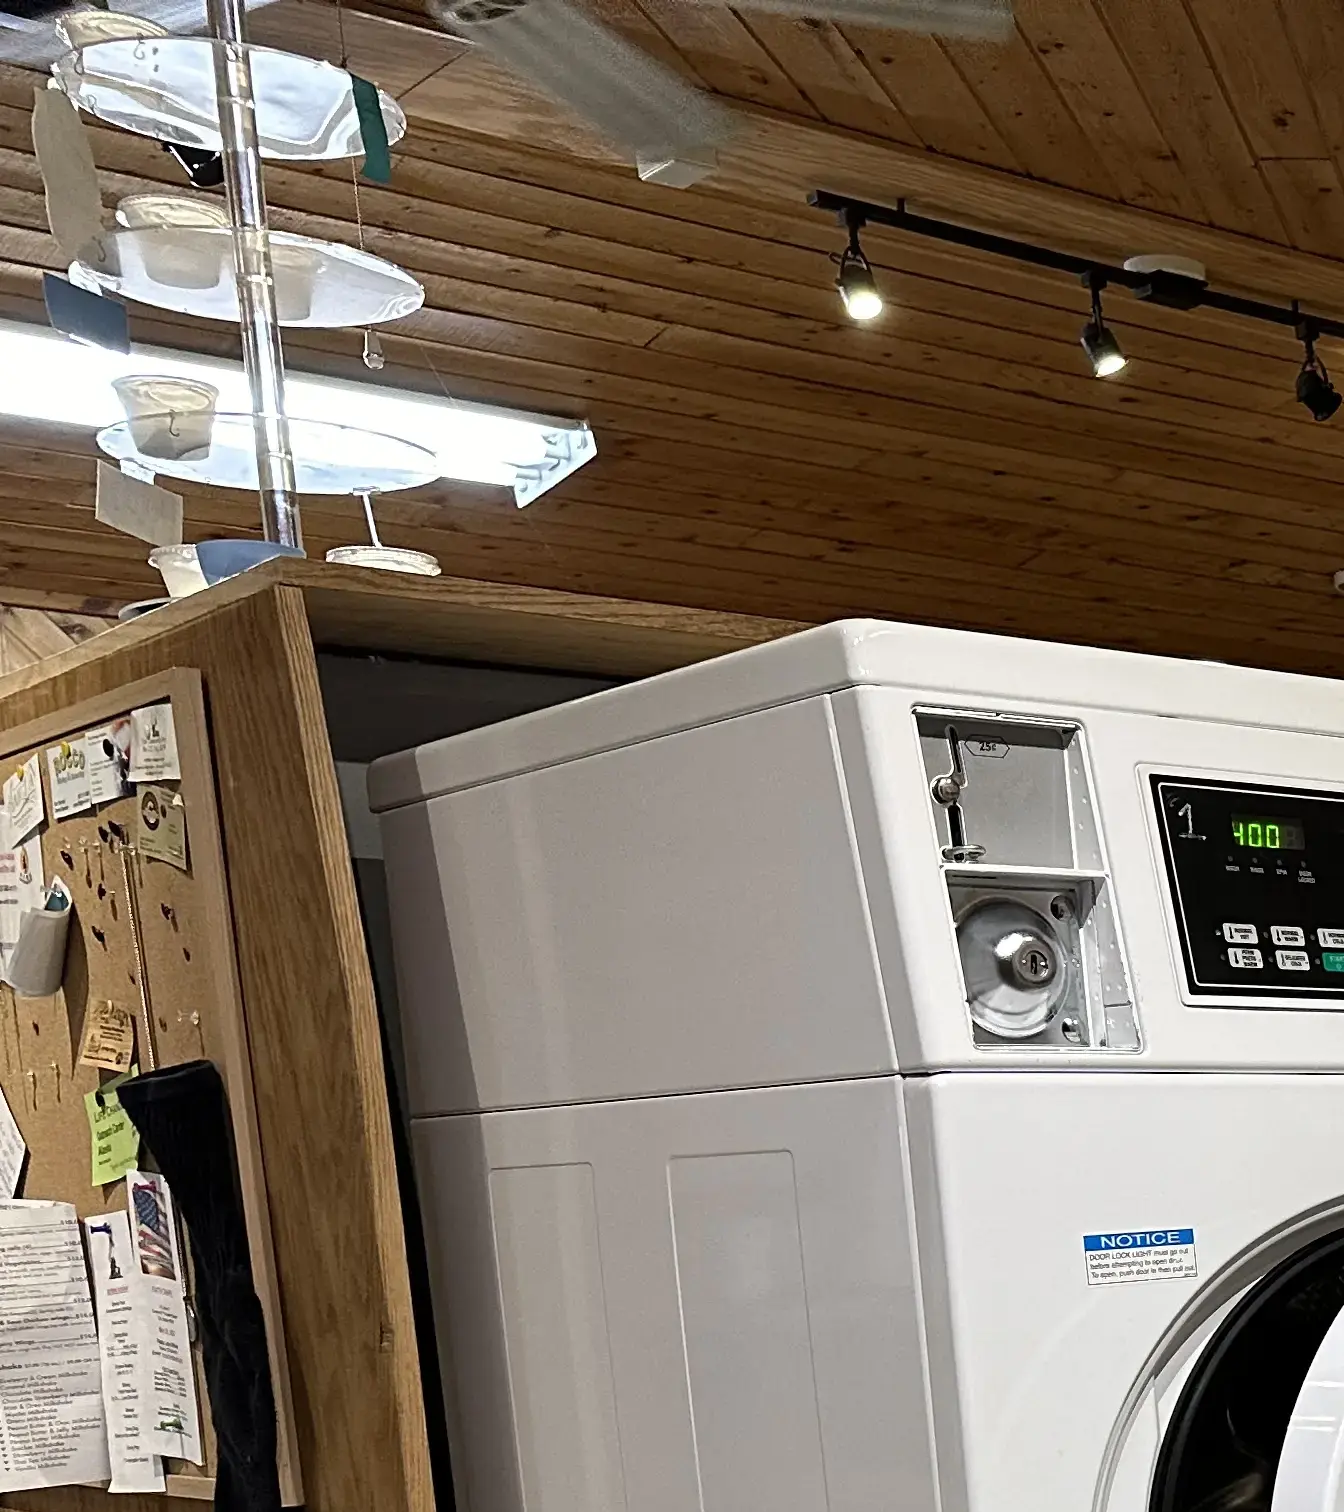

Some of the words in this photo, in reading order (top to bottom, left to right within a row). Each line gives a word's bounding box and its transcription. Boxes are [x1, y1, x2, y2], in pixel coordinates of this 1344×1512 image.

[1100, 1232, 1180, 1249] NOTICE
[1090, 1253, 1111, 1261] DOOR
[1112, 1251, 1131, 1260] LOCK
[1132, 1250, 1153, 1259] LIGHT
